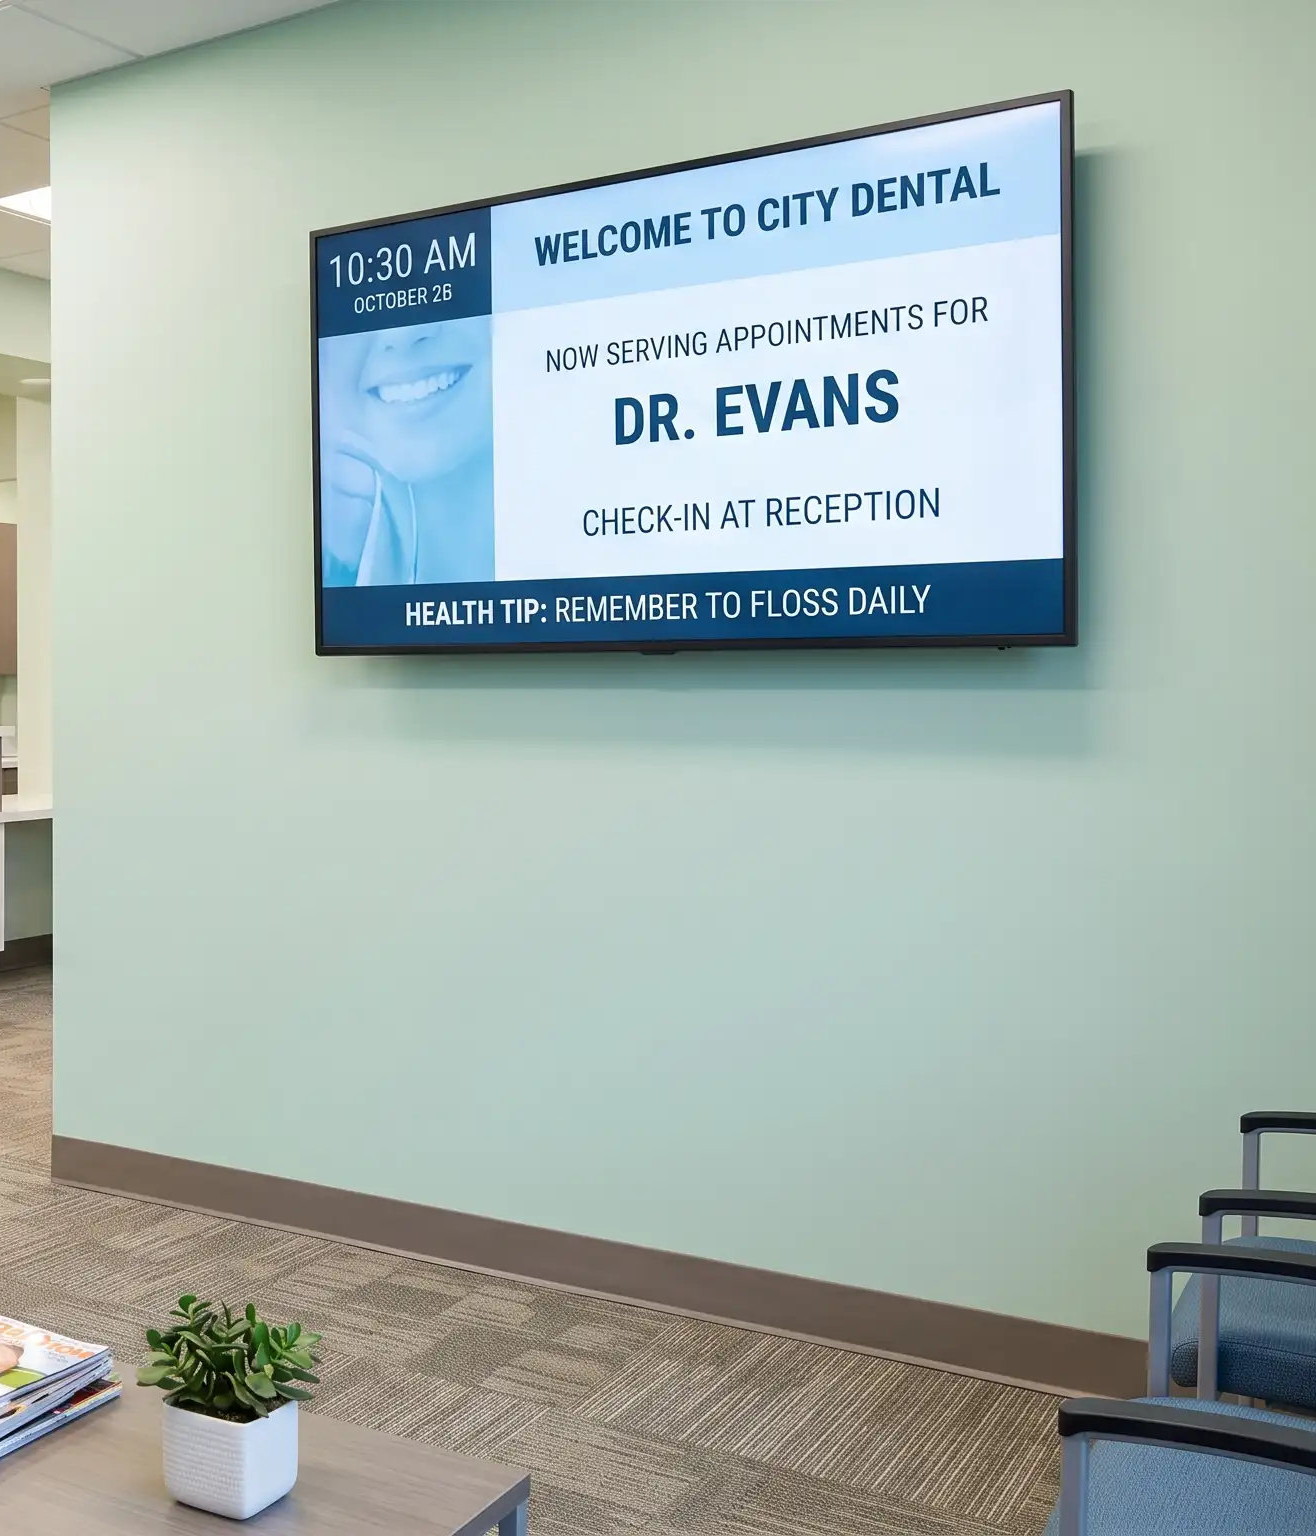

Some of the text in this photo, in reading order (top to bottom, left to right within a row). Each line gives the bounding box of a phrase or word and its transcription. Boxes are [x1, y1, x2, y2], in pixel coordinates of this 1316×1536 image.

[534, 161, 1001, 267] WELCOME TO CITY DENTAL
[329, 232, 476, 288] 10:30 AM
[354, 286, 428, 314] OCTOBER
[546, 296, 989, 373] NOW SERVING APPOINTMENTS FOR
[614, 369, 899, 446] DR. EVANS
[583, 487, 940, 537] CHECK-IN AT RECEPTION
[405, 584, 932, 626] HEALTH TIP: REMEMBER TO FLOSS DAILY
